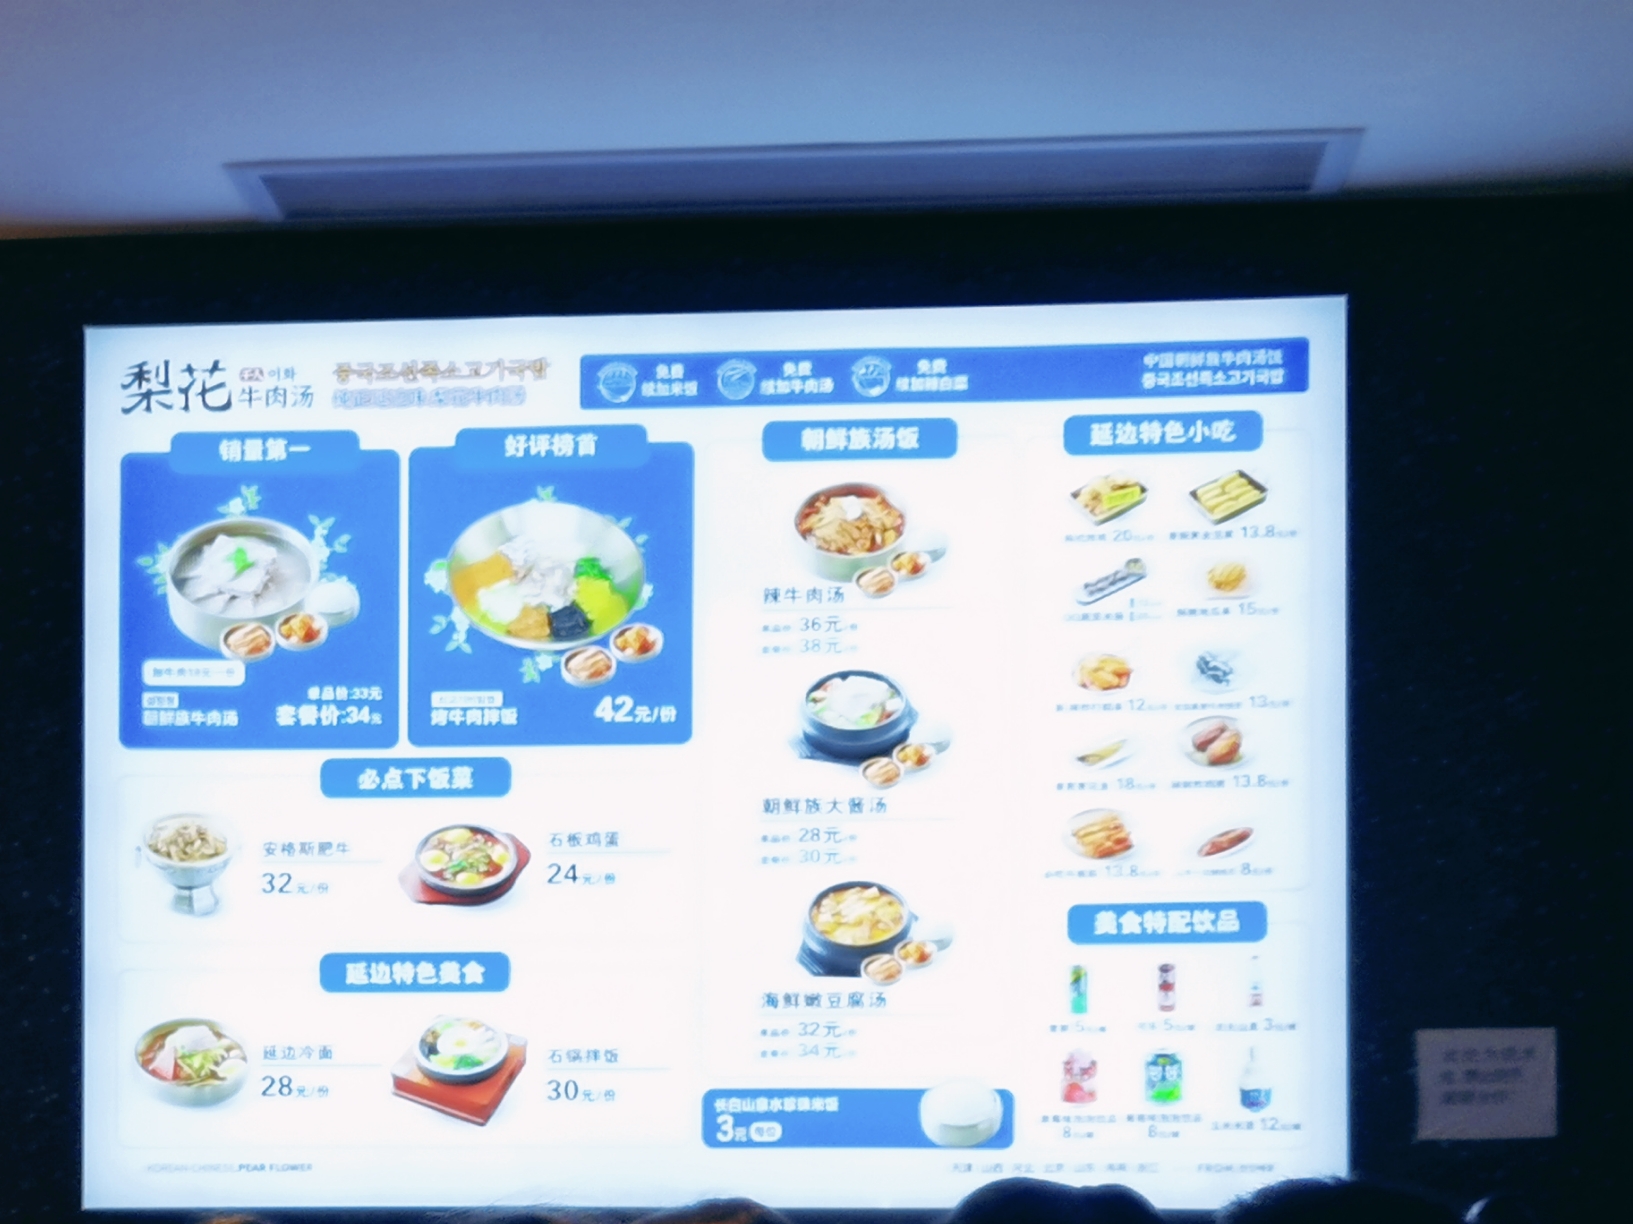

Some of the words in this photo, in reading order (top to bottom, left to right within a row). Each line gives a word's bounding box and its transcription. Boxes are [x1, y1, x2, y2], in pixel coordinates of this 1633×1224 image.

[121, 359, 232, 414] 梨花
[268, 366, 299, 382] 이화
[238, 384, 314, 409] 牛肉汤
[801, 426, 921, 451] 朝鲜族汤饭
[1089, 418, 1237, 447] 延边特色小吃
[219, 438, 312, 462] 销量第一
[504, 433, 598, 458] 好评榜首
[594, 695, 677, 723] 42元/份
[357, 766, 474, 790] 必点下饭菜
[263, 841, 351, 857] 安格斯肥牛
[1094, 908, 1240, 935] 美食特配饮品
[345, 960, 486, 985] 延边特色美食
[263, 1045, 333, 1060] 延边冷面
